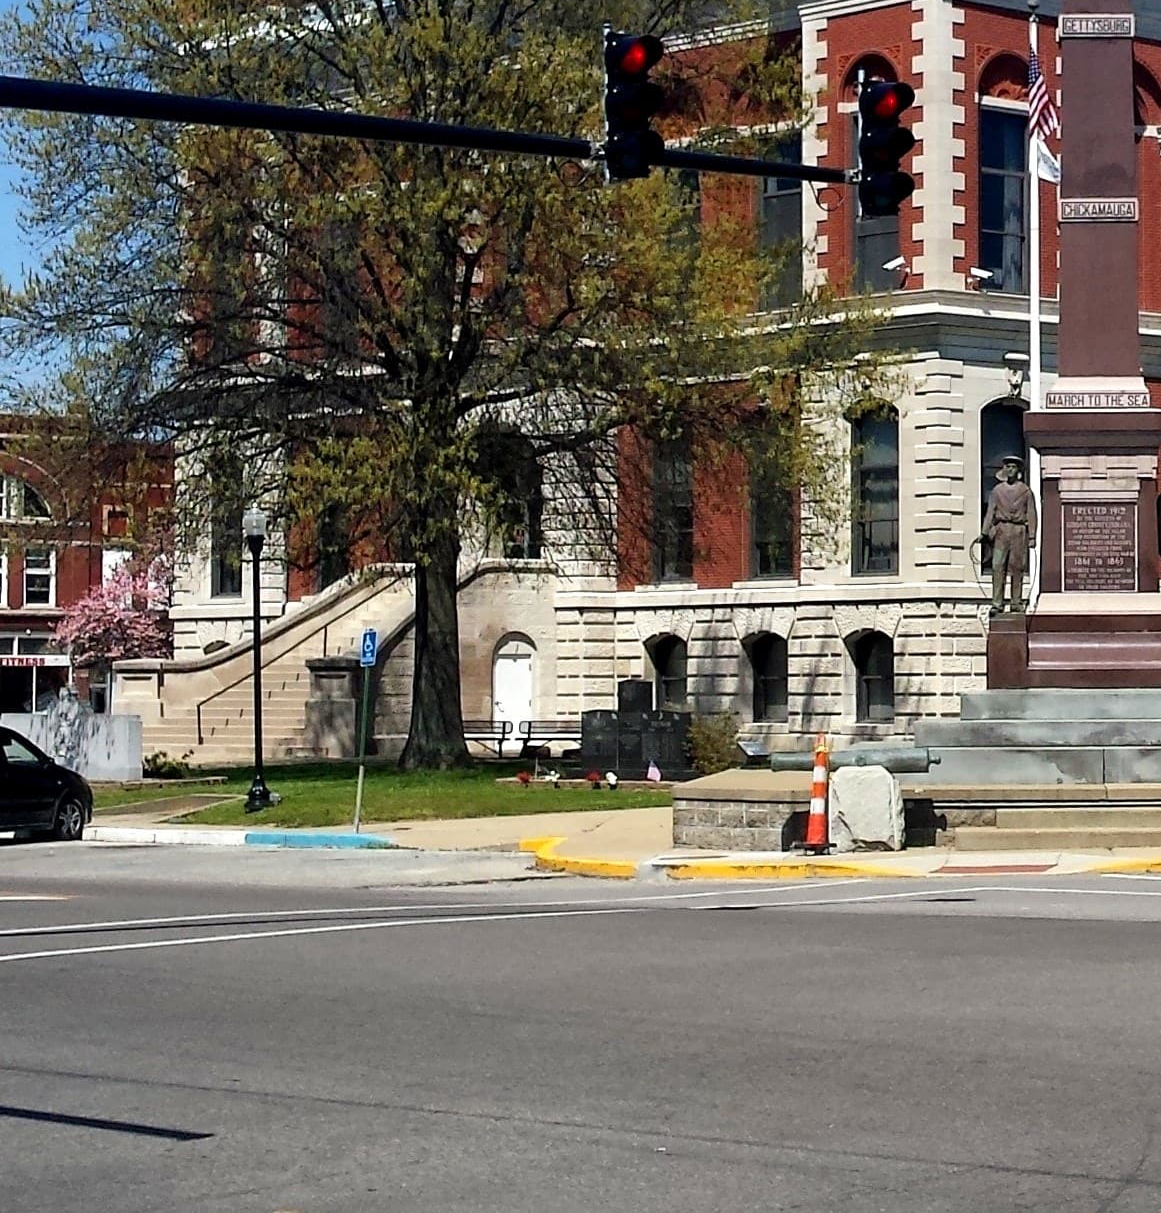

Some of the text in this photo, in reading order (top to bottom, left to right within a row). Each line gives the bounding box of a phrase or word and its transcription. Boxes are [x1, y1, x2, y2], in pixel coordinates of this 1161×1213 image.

[1064, 19, 1129, 32] GETTYSBURG
[1048, 394, 1148, 406] MARCH TO THE SEA
[1072, 506, 1107, 515] ERECTED
